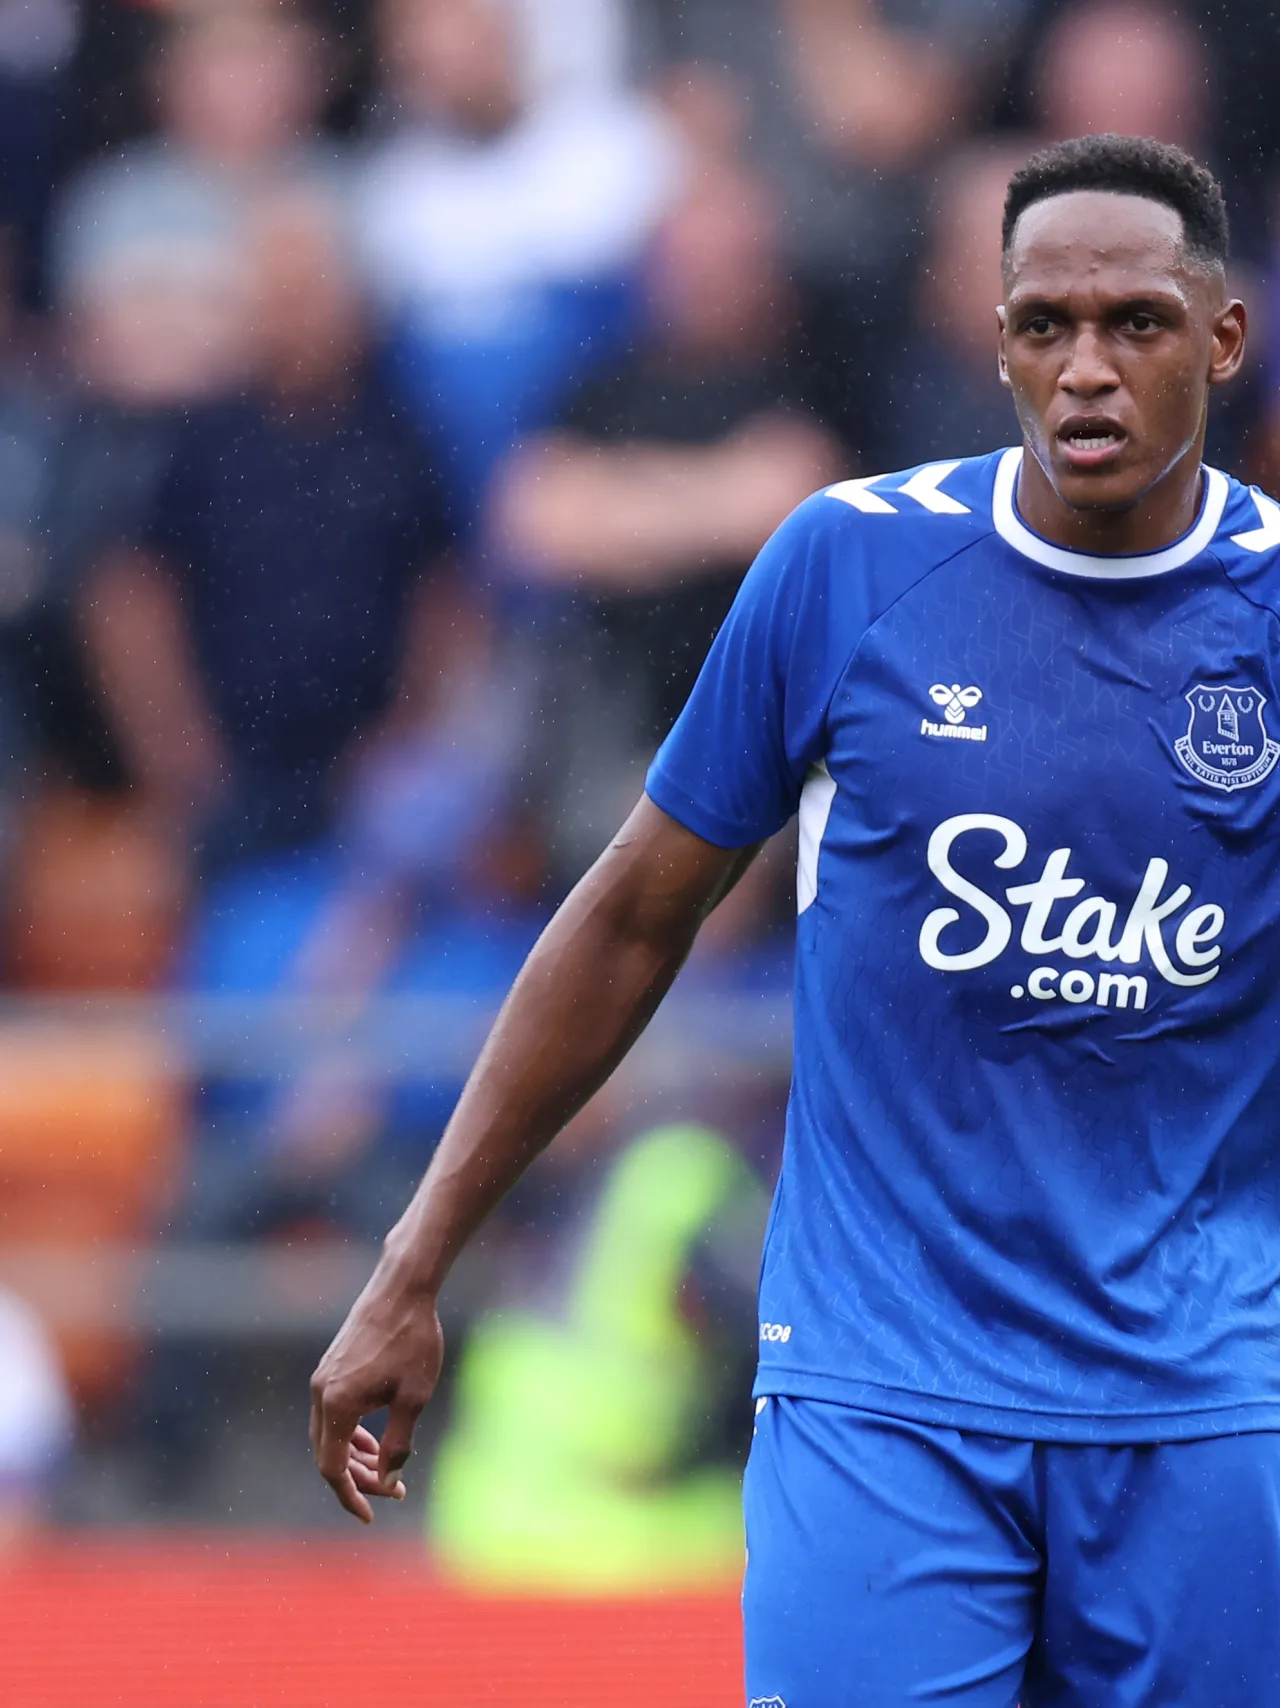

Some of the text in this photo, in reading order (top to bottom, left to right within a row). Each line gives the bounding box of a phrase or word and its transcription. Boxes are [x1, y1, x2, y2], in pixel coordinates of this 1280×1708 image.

[921, 719, 987, 741] hummel
[1202, 741, 1254, 756] Everton
[1221, 757, 1238, 766] 1878
[1184, 752, 1272, 785] NIL SATIS NISI OPTIMUM
[918, 813, 1226, 987] Stake
[1010, 966, 1148, 1010] .com
